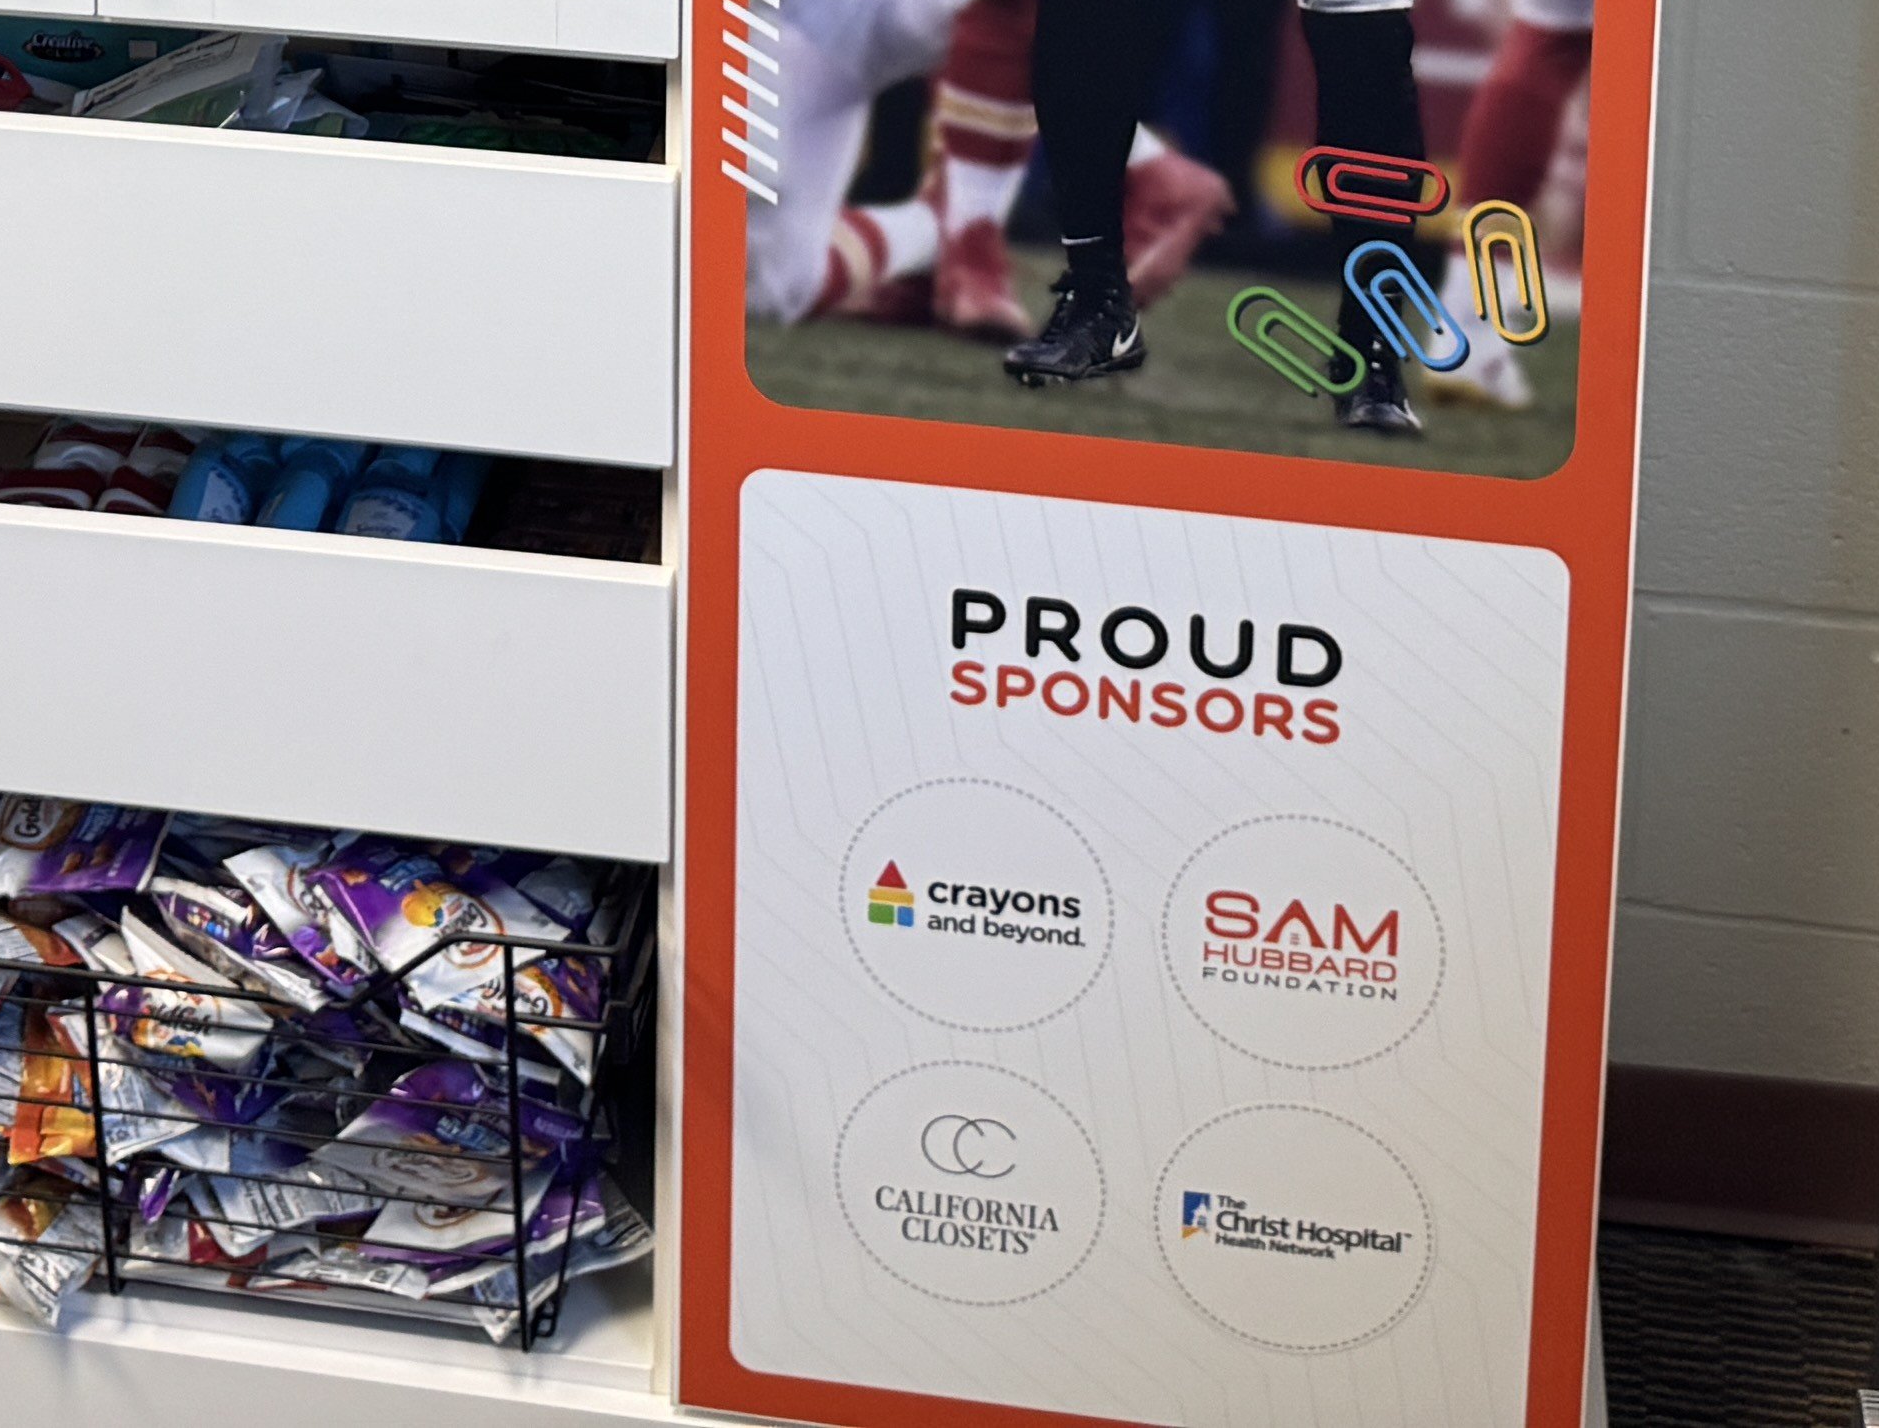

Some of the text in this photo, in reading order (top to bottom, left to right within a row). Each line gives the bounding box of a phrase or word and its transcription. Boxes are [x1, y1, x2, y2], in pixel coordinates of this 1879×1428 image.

[952, 588, 1343, 688] PROUD
[950, 660, 1341, 745] SPONSORS
[927, 881, 1081, 919] crayons
[927, 914, 1086, 947] and beyond.
[1205, 890, 1399, 957] SAM
[1203, 941, 1398, 983] HUBBARD
[1202, 966, 1397, 1001] FOUNDATION
[875, 1185, 1060, 1232] CALIFORNIA
[1217, 1194, 1247, 1210] The
[1216, 1210, 1291, 1239] Christ
[1215, 1233, 1335, 1260] Health Network
